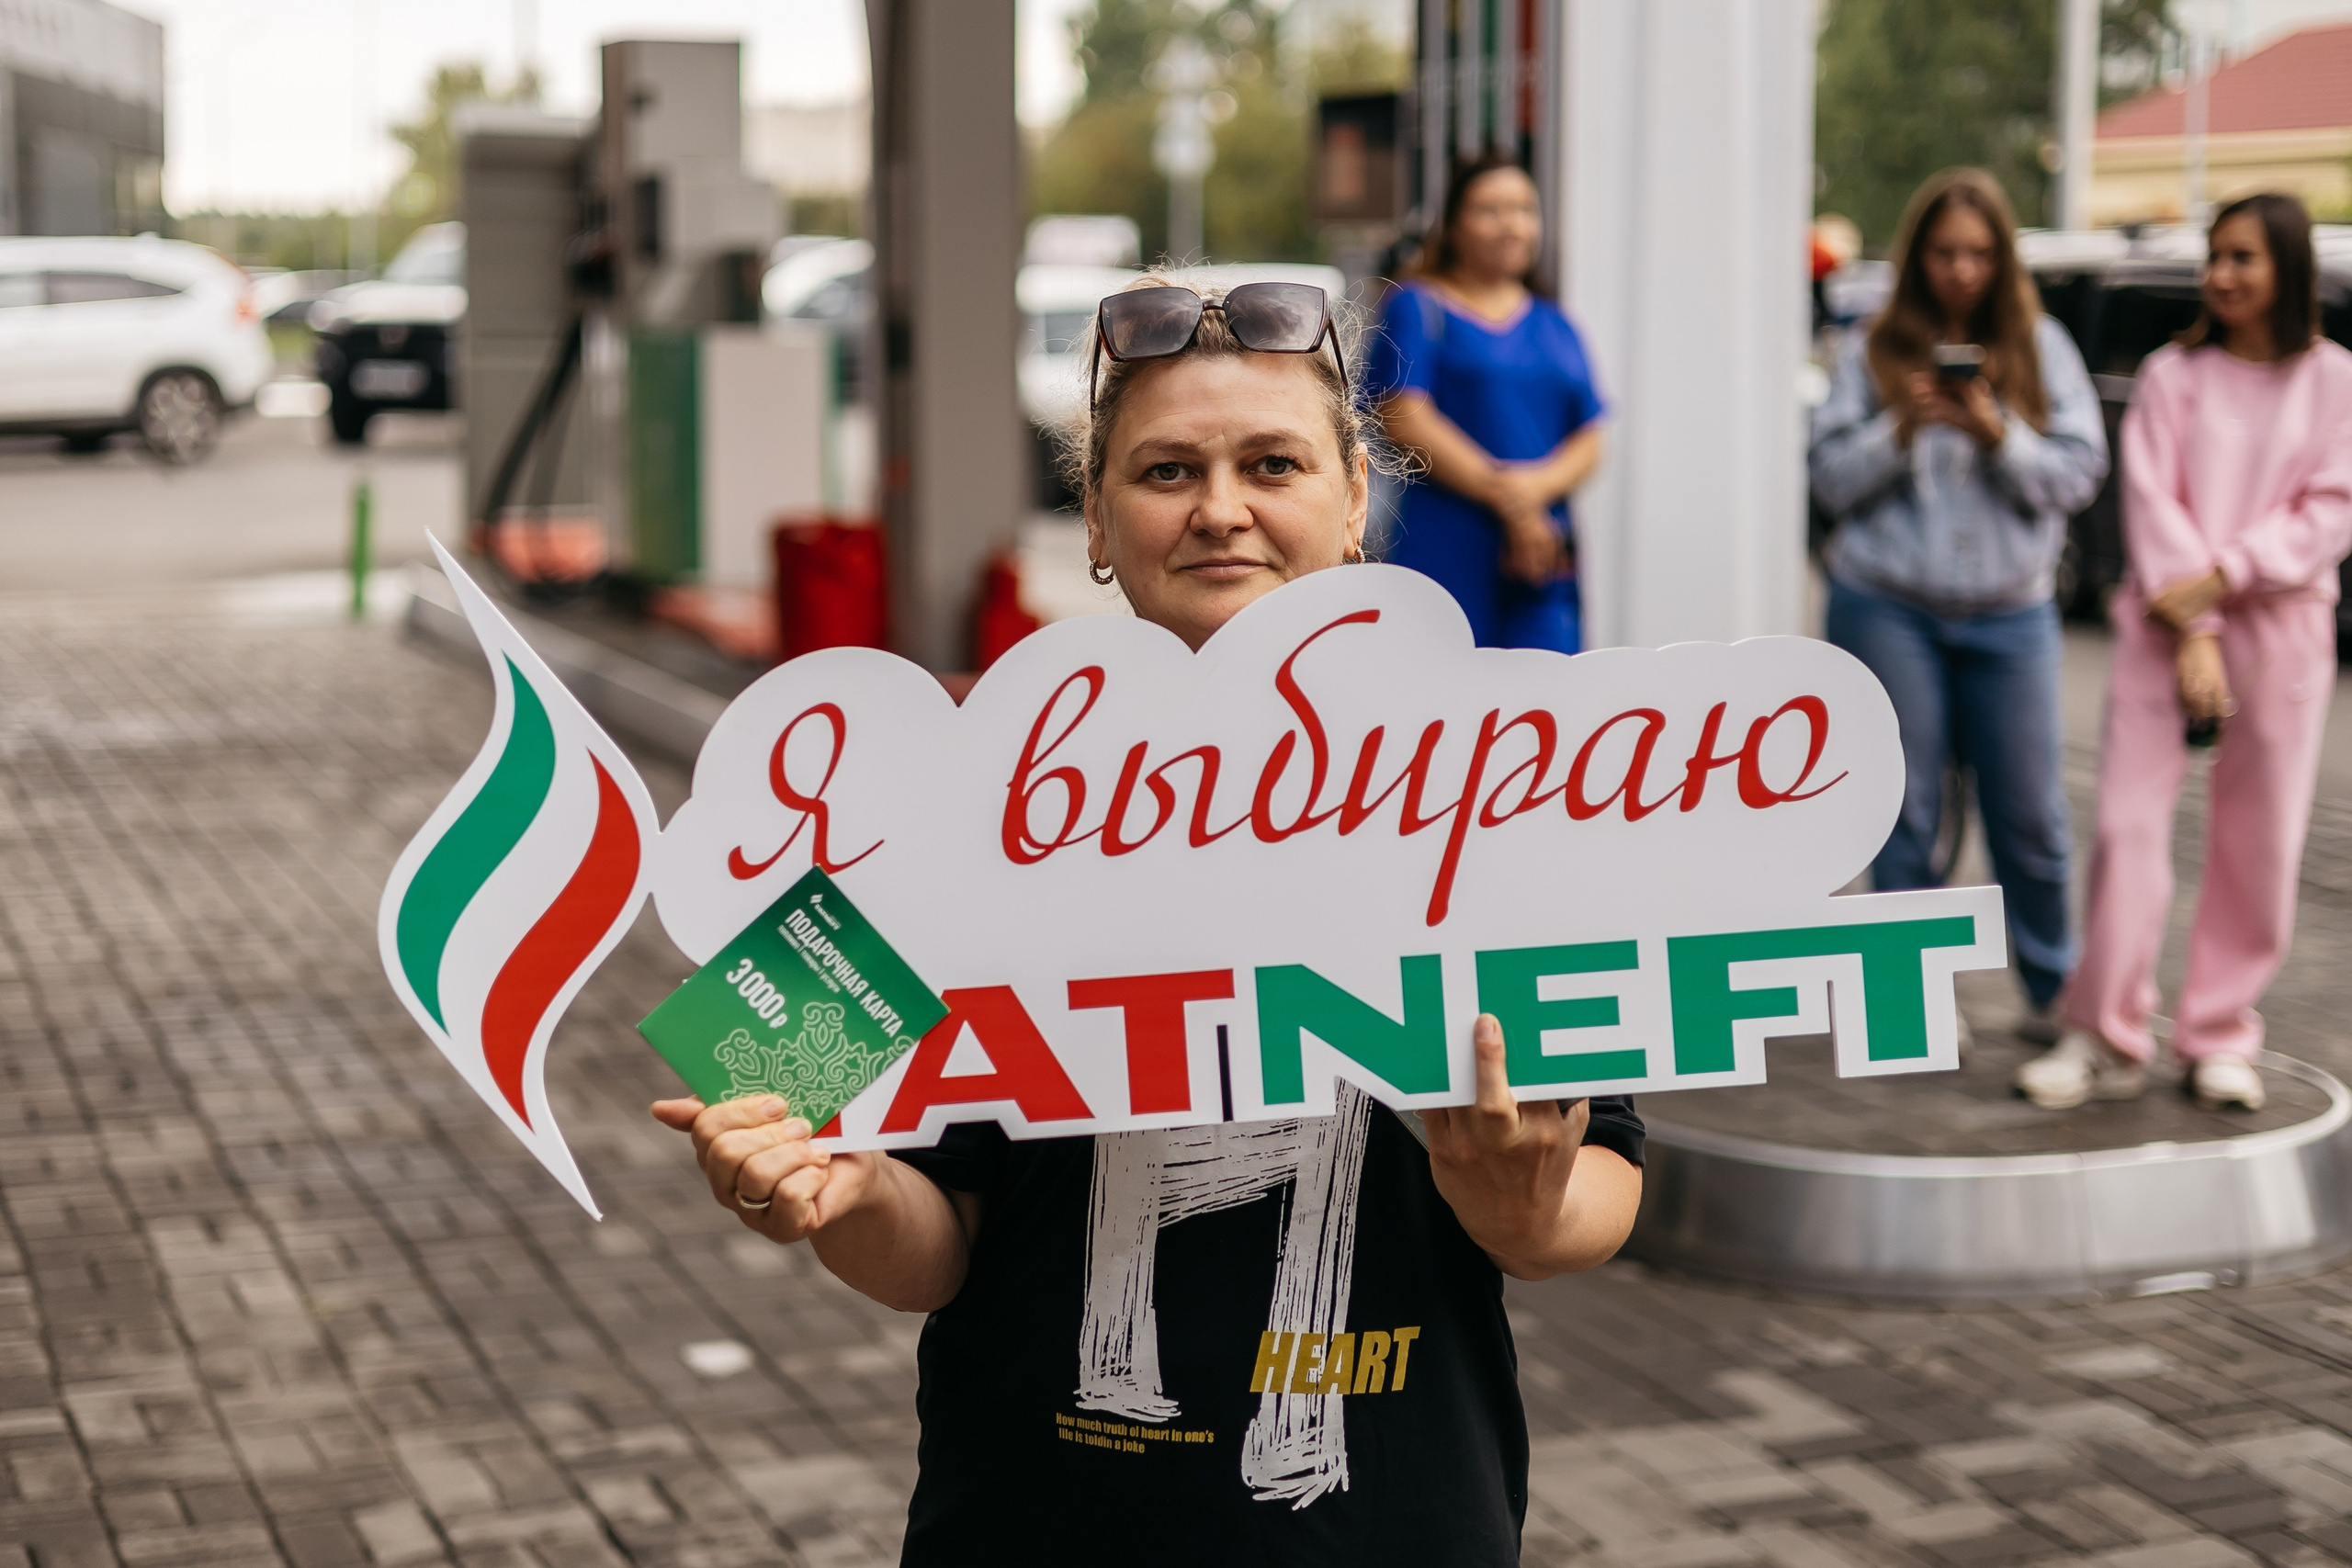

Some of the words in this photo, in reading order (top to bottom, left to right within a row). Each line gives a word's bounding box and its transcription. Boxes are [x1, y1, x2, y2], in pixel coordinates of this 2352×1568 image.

[728, 703, 885, 881] Я
[1001, 608, 1849, 928] выбираю
[785, 908, 869, 998] ПОДАРОЧНАЯ
[859, 989, 904, 1039] КАРТА
[810, 915, 1976, 1140] ATNEFT
[1250, 1325, 1420, 1394] HEART
[1056, 1412, 1075, 1427] How
[1076, 1417, 1102, 1433] much
[1102, 1422, 1128, 1437] truth
[1141, 1426, 1170, 1441] heart
[1170, 1428, 1182, 1442] in
[1183, 1429, 1215, 1443] one's
[1075, 1430, 1083, 1443] is
[1114, 1439, 1121, 1450] a
[1122, 1438, 1146, 1454] joke
